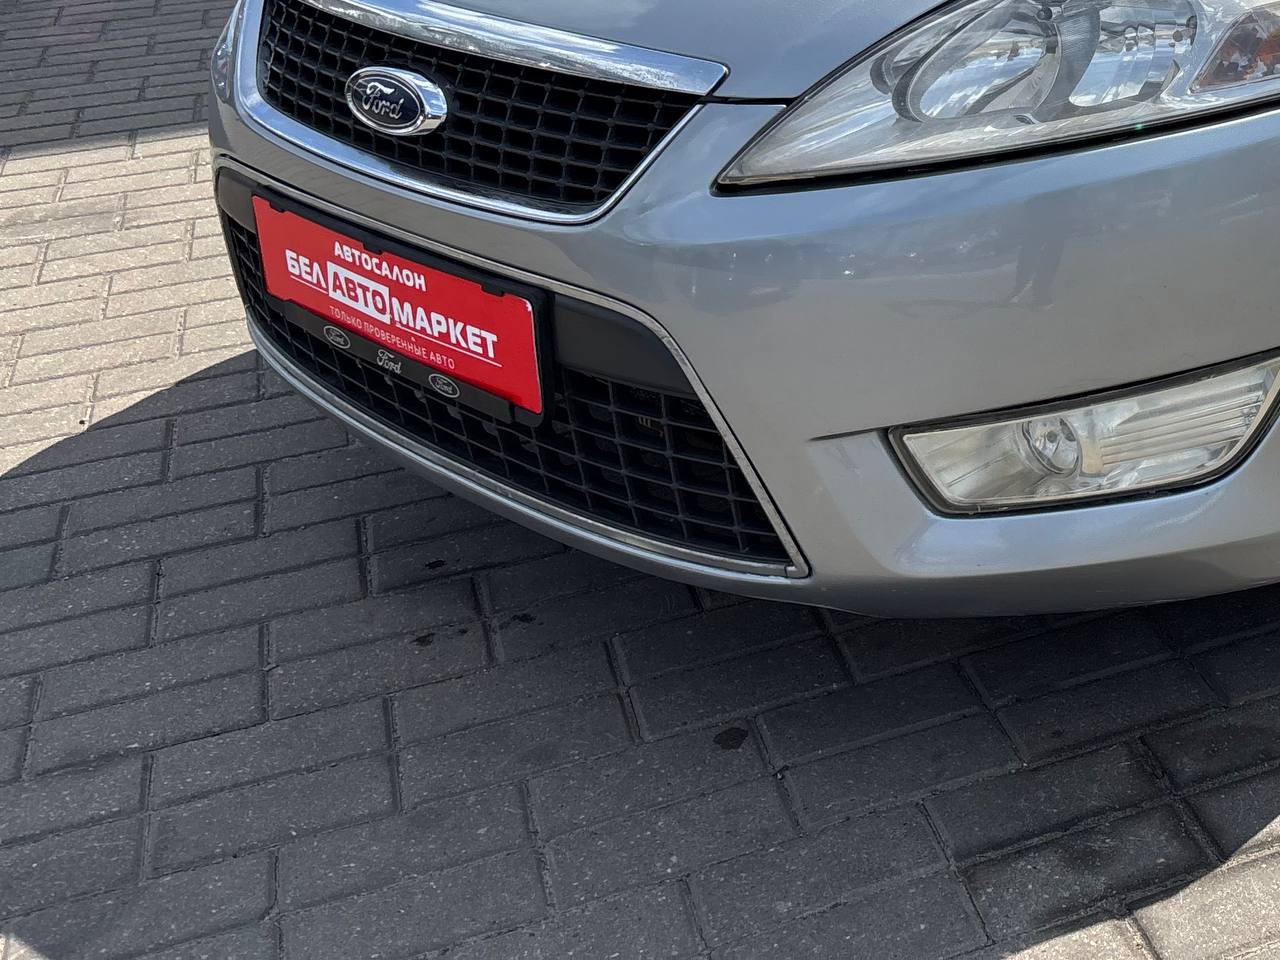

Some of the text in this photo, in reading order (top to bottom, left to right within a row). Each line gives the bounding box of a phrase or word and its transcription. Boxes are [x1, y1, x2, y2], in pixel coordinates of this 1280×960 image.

[362, 82, 404, 119] Ford
[334, 241, 427, 292] АВТОСАЛОН
[329, 305, 455, 370] ТОЛЬКО ПРОВЕРЕННЫЕ АВТО
[376, 349, 402, 374] Ford
